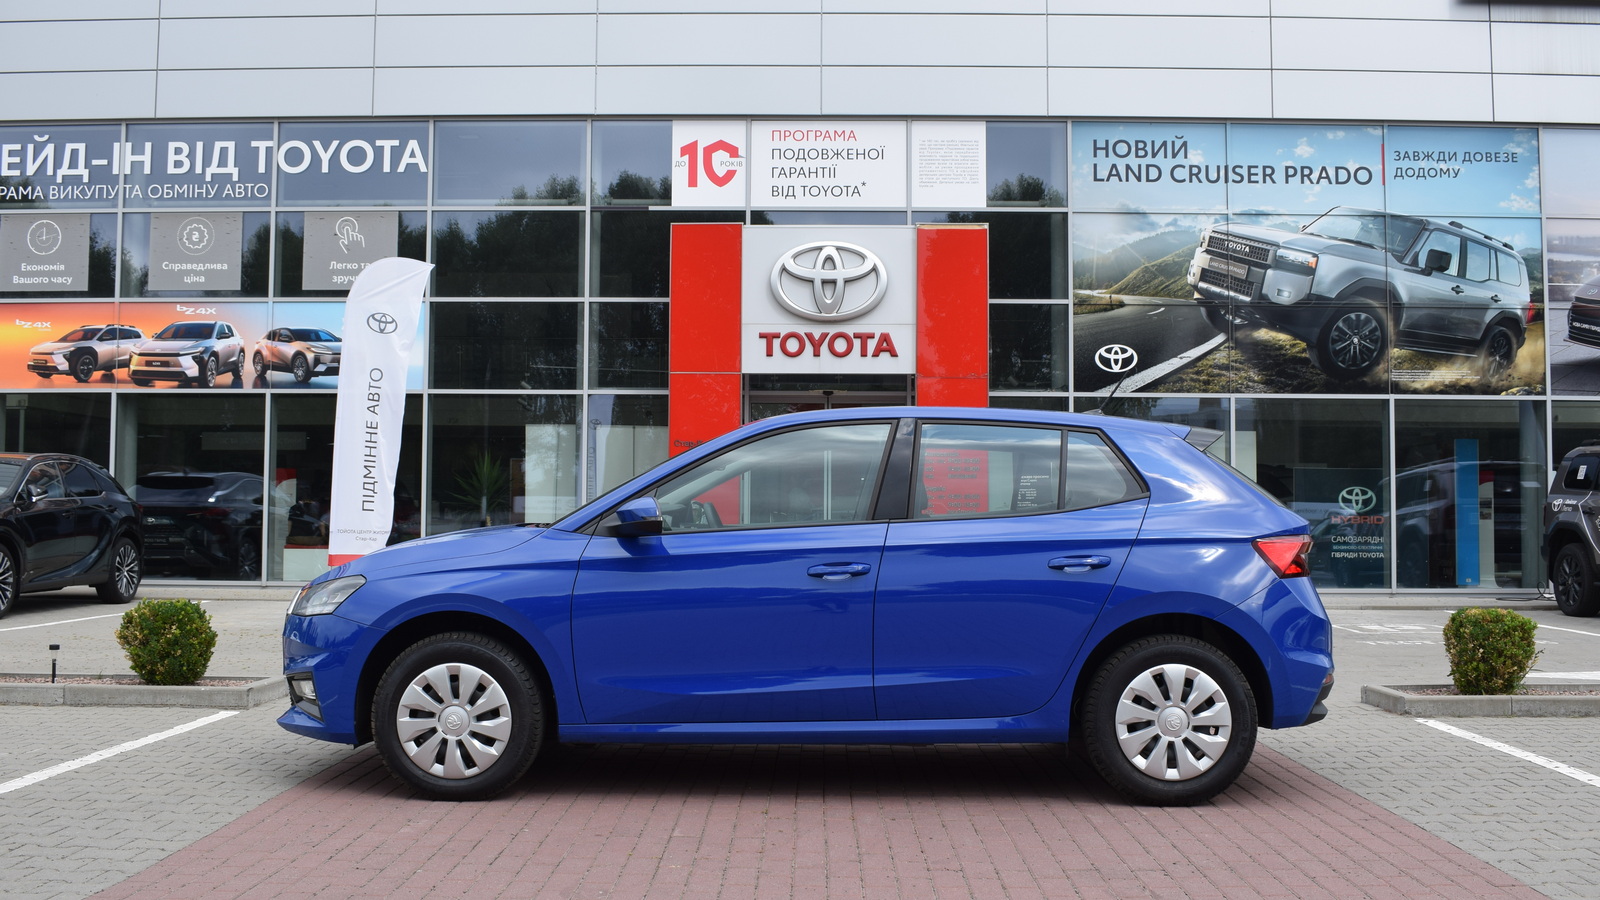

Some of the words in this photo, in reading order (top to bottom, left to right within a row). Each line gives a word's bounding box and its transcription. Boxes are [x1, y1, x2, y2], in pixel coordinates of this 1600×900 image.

[771, 130, 858, 142] ПРОГРАМА
[771, 145, 886, 162] ПОДОВЖЕНОЇ
[1092, 135, 1189, 159] НОВИЙ
[167, 141, 239, 182] ВІД
[250, 139, 428, 174] TOYOTA
[1393, 150, 1458, 164] ЗАВЖДИ
[1462, 151, 1518, 164] ДОВЕЗЕ
[674, 160, 686, 168] ДО
[720, 160, 743, 168] РОКІВ
[771, 163, 837, 179] ГАРАНТІЇ
[1092, 163, 1163, 183] LAND
[1169, 164, 1277, 185] CRUISER
[1284, 165, 1373, 186] PRADO
[1393, 167, 1461, 180] ДОДОМУ
[50, 184, 120, 199] ВИКУПУ
[124, 184, 143, 198] ТА
[147, 183, 219, 198] ОБМІНУ
[222, 183, 269, 198] АВТО
[771, 185, 796, 199] ВІД
[1224, 240, 1250, 253] TOYOTA
[21, 262, 65, 272] Економія
[162, 261, 228, 272] Справедлива
[329, 261, 359, 270] Легко
[12, 275, 49, 284] Вашого
[51, 276, 73, 285] часу
[184, 274, 205, 283] ціна
[331, 275, 358, 284] зруч
[758, 331, 899, 358] TOYOTA
[366, 367, 384, 416] АВТО
[674, 440, 703, 448] Стар-К
[361, 420, 379, 512] ПІДМІННЕ
[1331, 515, 1385, 525] HYBRID
[1331, 536, 1385, 544] САМОЗАРЯДНІ
